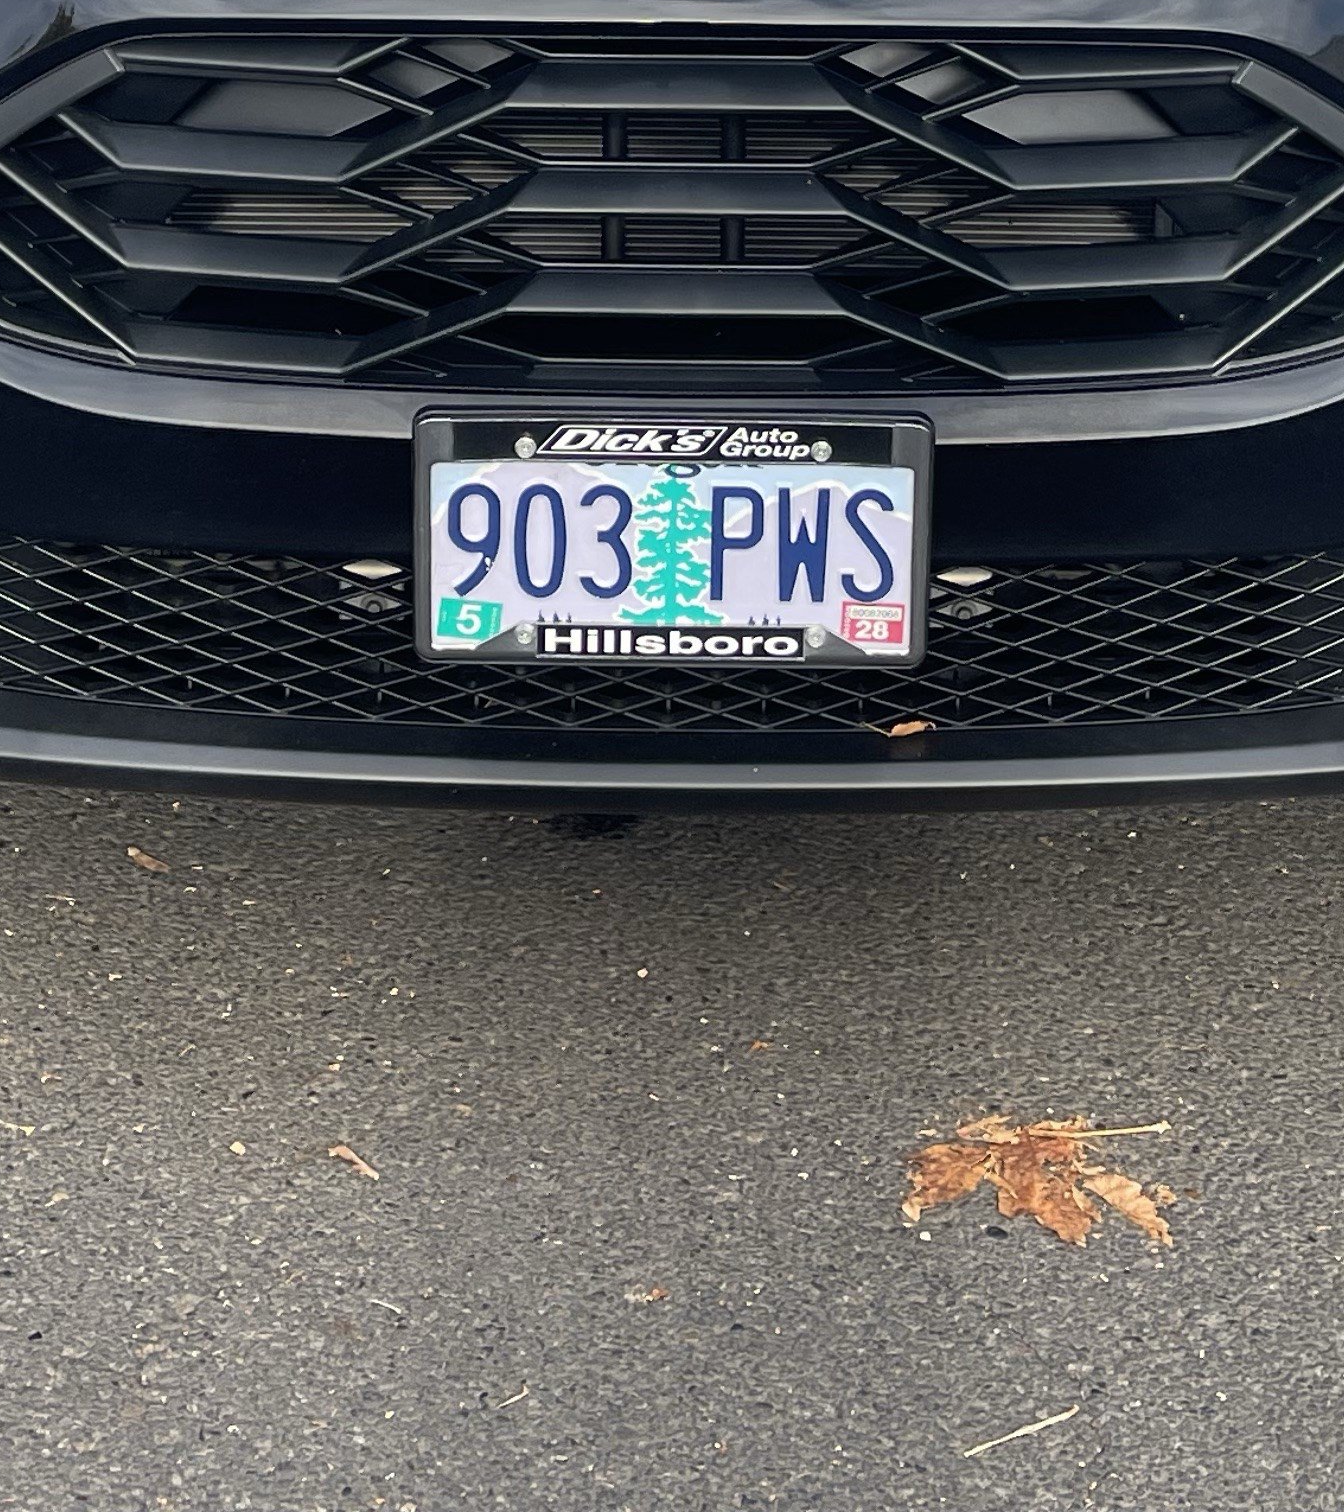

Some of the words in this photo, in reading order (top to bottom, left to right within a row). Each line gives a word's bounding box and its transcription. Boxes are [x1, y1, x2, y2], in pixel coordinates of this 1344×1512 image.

[550, 427, 703, 453] Dick's
[728, 427, 799, 444] Auto
[719, 439, 811, 461] Group
[447, 482, 633, 599] 903
[709, 486, 895, 603] PWS
[455, 603, 482, 636] 5
[854, 619, 890, 641] 28
[543, 628, 800, 656] Hillsboro
